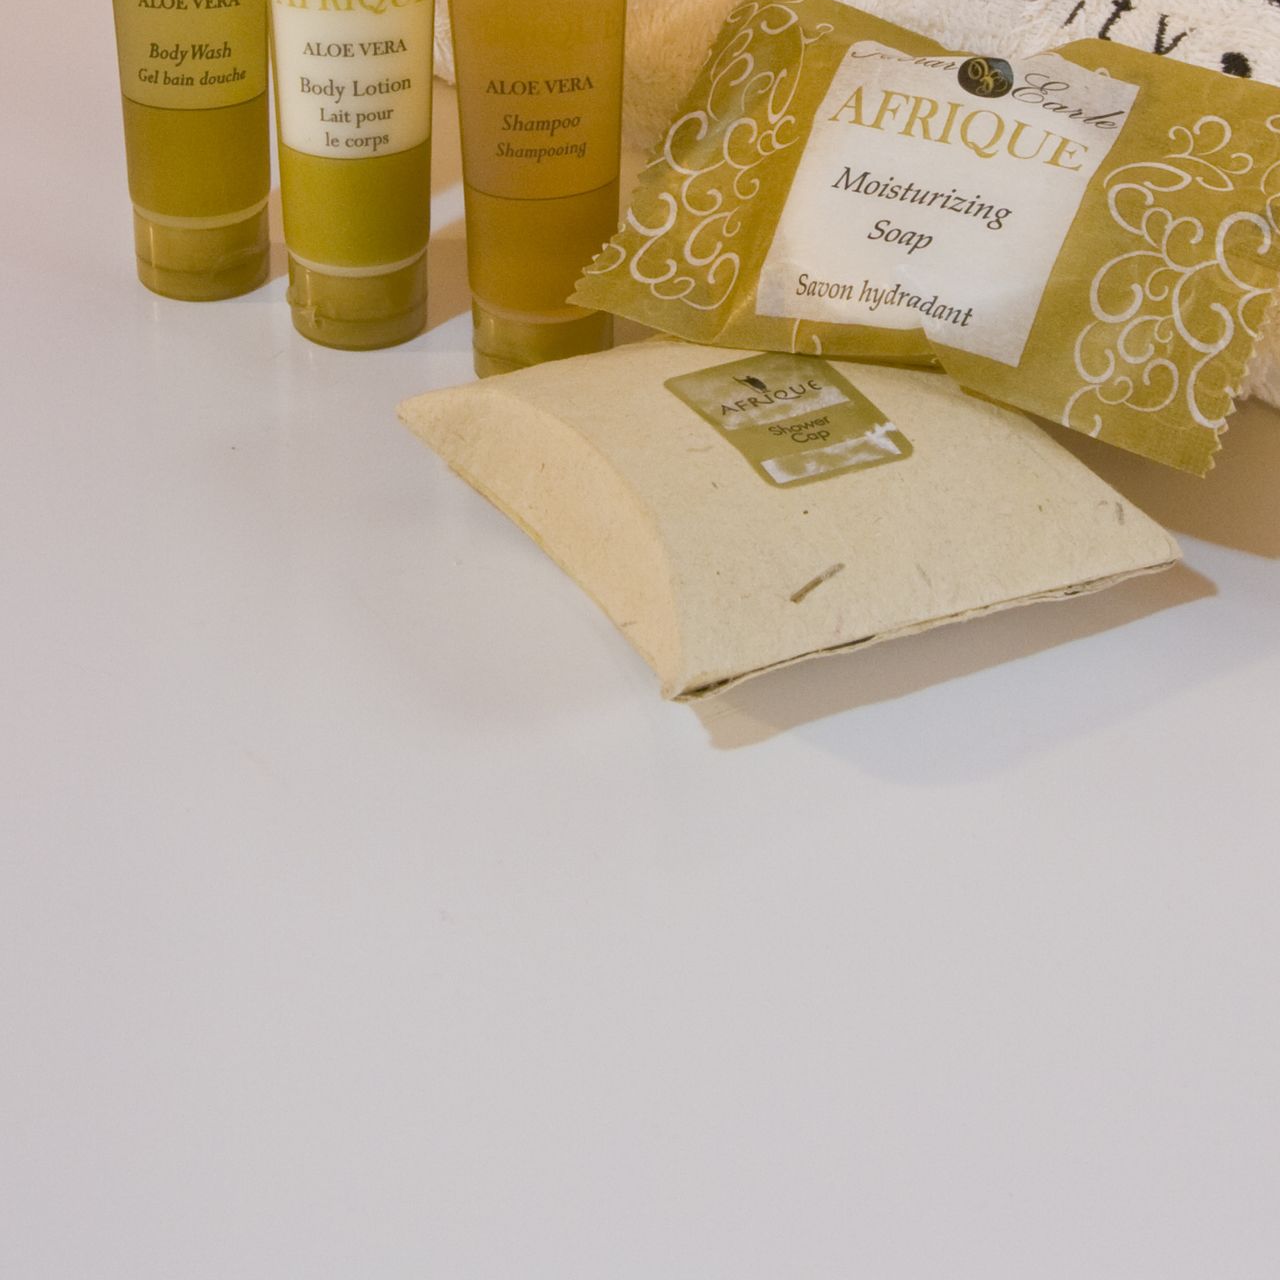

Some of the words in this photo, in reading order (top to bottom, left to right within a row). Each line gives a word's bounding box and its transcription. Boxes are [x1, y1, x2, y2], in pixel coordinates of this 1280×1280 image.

[149, 43, 188, 66] Body
[191, 41, 231, 60] Wash
[303, 42, 355, 57] ALOE
[360, 39, 408, 54] VERA
[138, 68, 158, 84] Gel
[163, 70, 194, 86] bain
[200, 68, 246, 85] douche
[486, 80, 539, 95] ALOE
[544, 76, 594, 94] VERA
[300, 77, 345, 103] Body
[352, 78, 411, 97] Lotion
[1011, 73, 1125, 130] Earle
[320, 107, 351, 123] Lait
[356, 108, 394, 128] pour
[502, 114, 581, 136] Shampoo
[828, 85, 1089, 172] AFRIQUE
[325, 132, 340, 148] le
[345, 134, 389, 151] corps
[496, 142, 587, 163] Shampooing
[832, 166, 1012, 230] Moisturizing
[868, 219, 933, 255] Soap
[795, 273, 853, 301] Savon
[858, 279, 973, 328] hydradant
[721, 379, 822, 416] AFRIQUE
[768, 415, 830, 437] Shower
[791, 429, 831, 444] Cap
